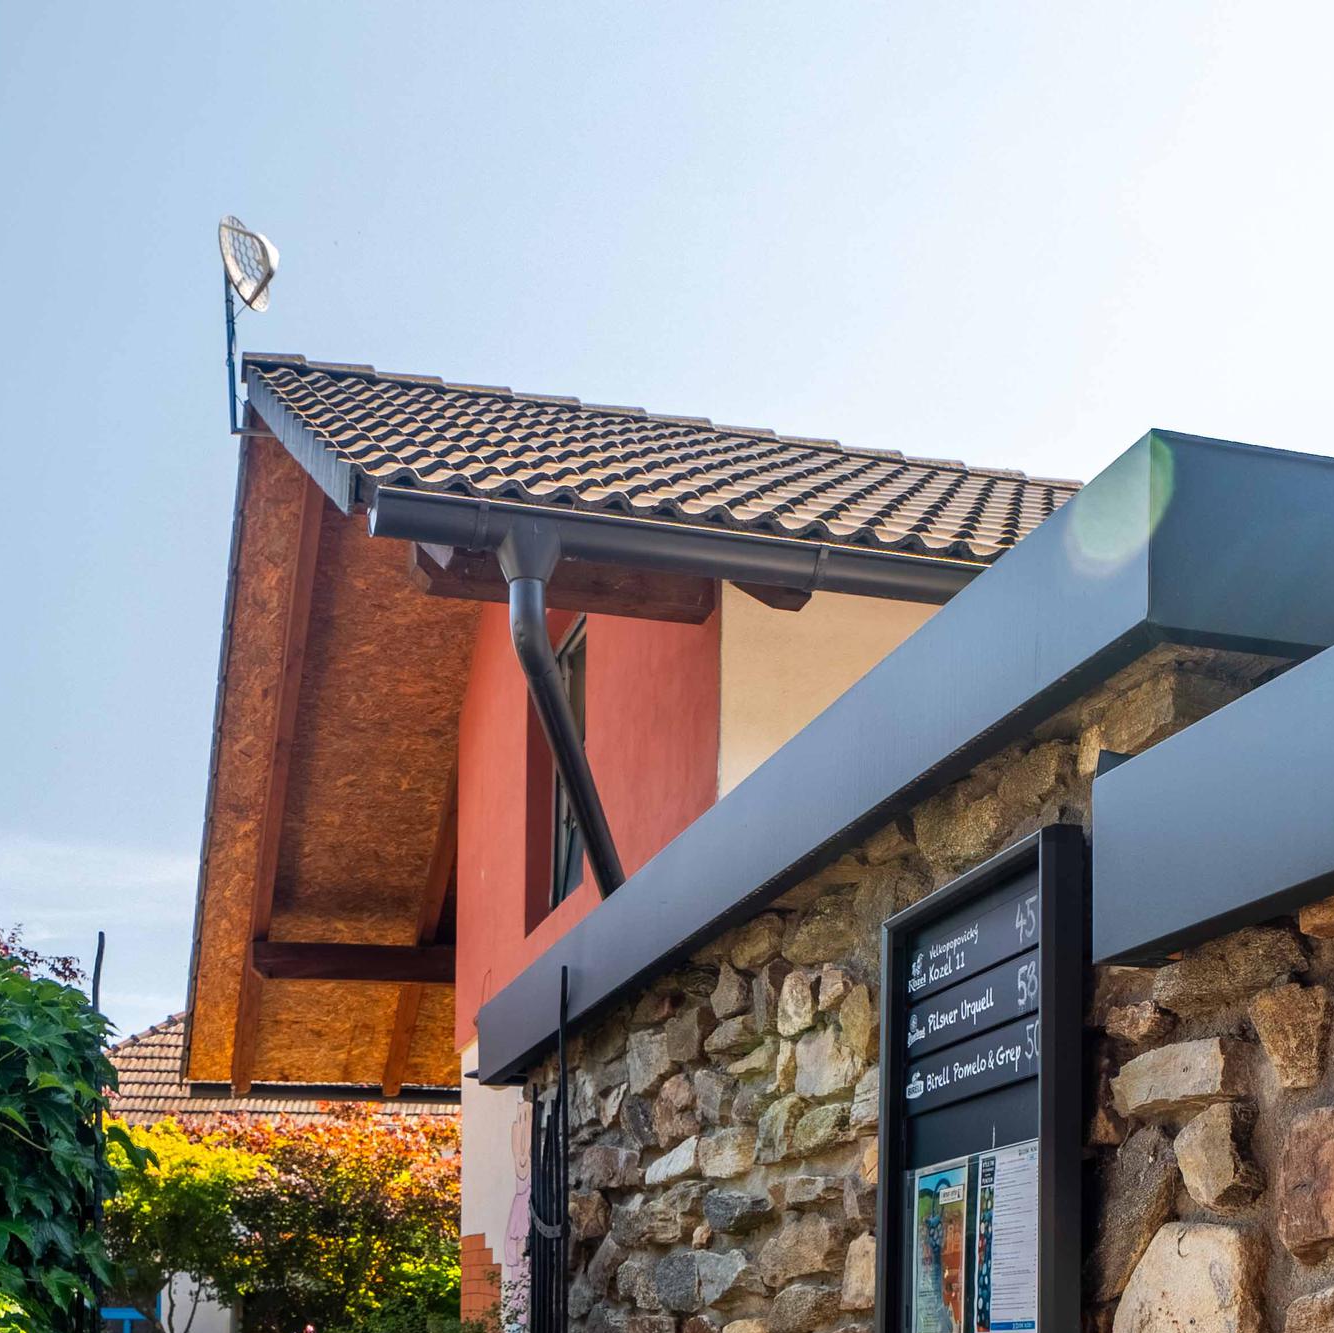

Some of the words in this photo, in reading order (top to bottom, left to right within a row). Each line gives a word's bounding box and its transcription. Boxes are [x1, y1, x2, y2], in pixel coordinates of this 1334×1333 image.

[1016, 895, 1038, 944] 45
[929, 955, 953, 984] Kozel
[955, 951, 965, 970] 11
[1017, 961, 1038, 1006] 58
[928, 1010, 959, 1034] Pilsner
[960, 987, 994, 1025] Urquell
[927, 1066, 950, 1092] Birell
[953, 1053, 987, 1082] Pomelo
[996, 1045, 1022, 1072] Grep
